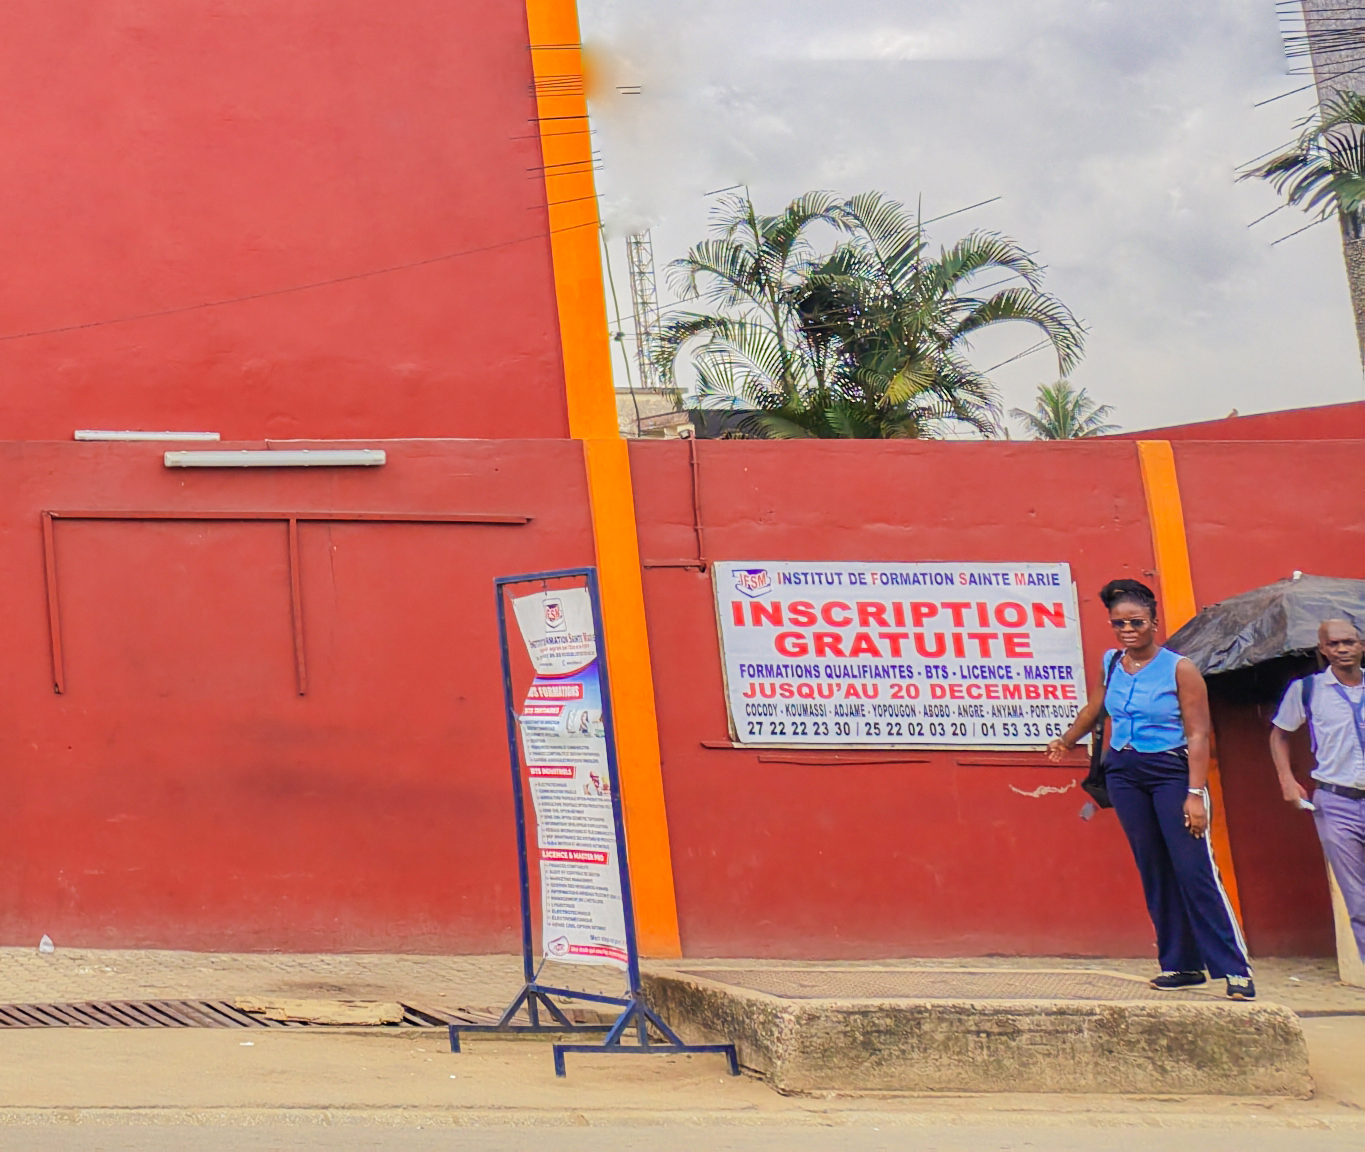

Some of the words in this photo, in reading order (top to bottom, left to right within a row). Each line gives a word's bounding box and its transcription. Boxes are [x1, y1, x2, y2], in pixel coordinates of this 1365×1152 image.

[777, 572, 843, 586] INSTITUT
[849, 572, 867, 586] DE
[871, 572, 955, 586] FORMATION
[959, 572, 1011, 586] SAINTE
[1014, 572, 1060, 586] MARIE
[731, 601, 1067, 628] INSCRIPTION
[774, 631, 1034, 659] GRATUITE
[739, 663, 820, 679] FORMATIONS
[825, 664, 914, 679] QUALIFIANTES
[924, 665, 949, 679] BTS
[959, 665, 1014, 679] LICENCE
[1024, 665, 1074, 680] MASTER
[742, 682, 879, 700] JUSQU'AU
[889, 683, 920, 699] 20
[930, 683, 1078, 700] DECEMBRE
[745, 703, 778, 717] COCODY
[785, 703, 827, 718] KOUMASSI
[872, 703, 917, 718] YOPOUGON
[923, 704, 951, 718] ABOBO
[957, 704, 985, 718] ANGRE
[991, 704, 1025, 718] ANYAMA
[747, 722, 763, 736] 27
[770, 722, 786, 736] 22
[791, 722, 808, 736] 22
[812, 722, 829, 736] 23
[835, 722, 851, 736] 30
[864, 722, 881, 736] 25
[886, 722, 903, 736] 22
[908, 722, 924, 736] 02
[929, 722, 946, 736] 03
[951, 722, 967, 736] 20
[981, 722, 996, 736] 01
[1003, 722, 1018, 736] 53
[1024, 722, 1040, 736] 33
[1046, 722, 1062, 736] 65
